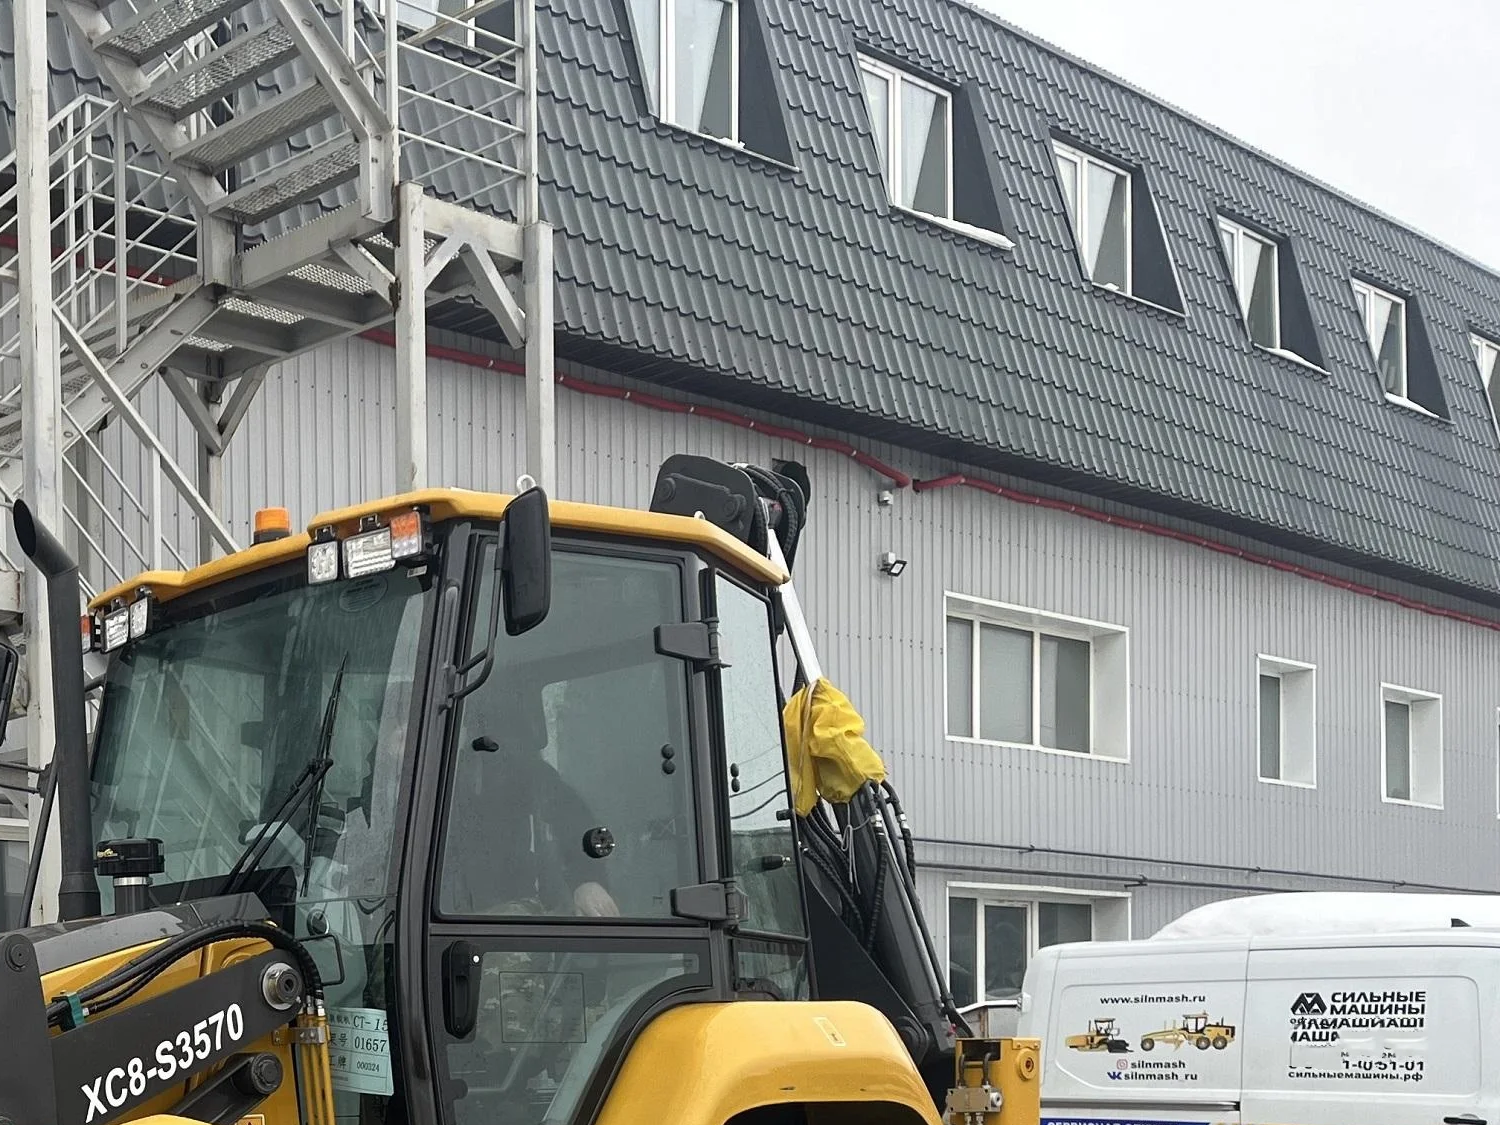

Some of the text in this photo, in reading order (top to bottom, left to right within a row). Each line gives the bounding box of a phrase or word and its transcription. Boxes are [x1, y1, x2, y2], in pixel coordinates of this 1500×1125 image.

[1100, 993, 1206, 1004] www.silnmash.ru
[1331, 991, 1426, 1003] СИЛЬНЫЕ
[1330, 1003, 1425, 1015] МАШИНЫ
[354, 1036, 387, 1052] 01657
[81, 1003, 244, 1124] XC8-S3570
[1131, 1060, 1186, 1069] silnmash
[1288, 1071, 1423, 1082] сильныемашины.рф
